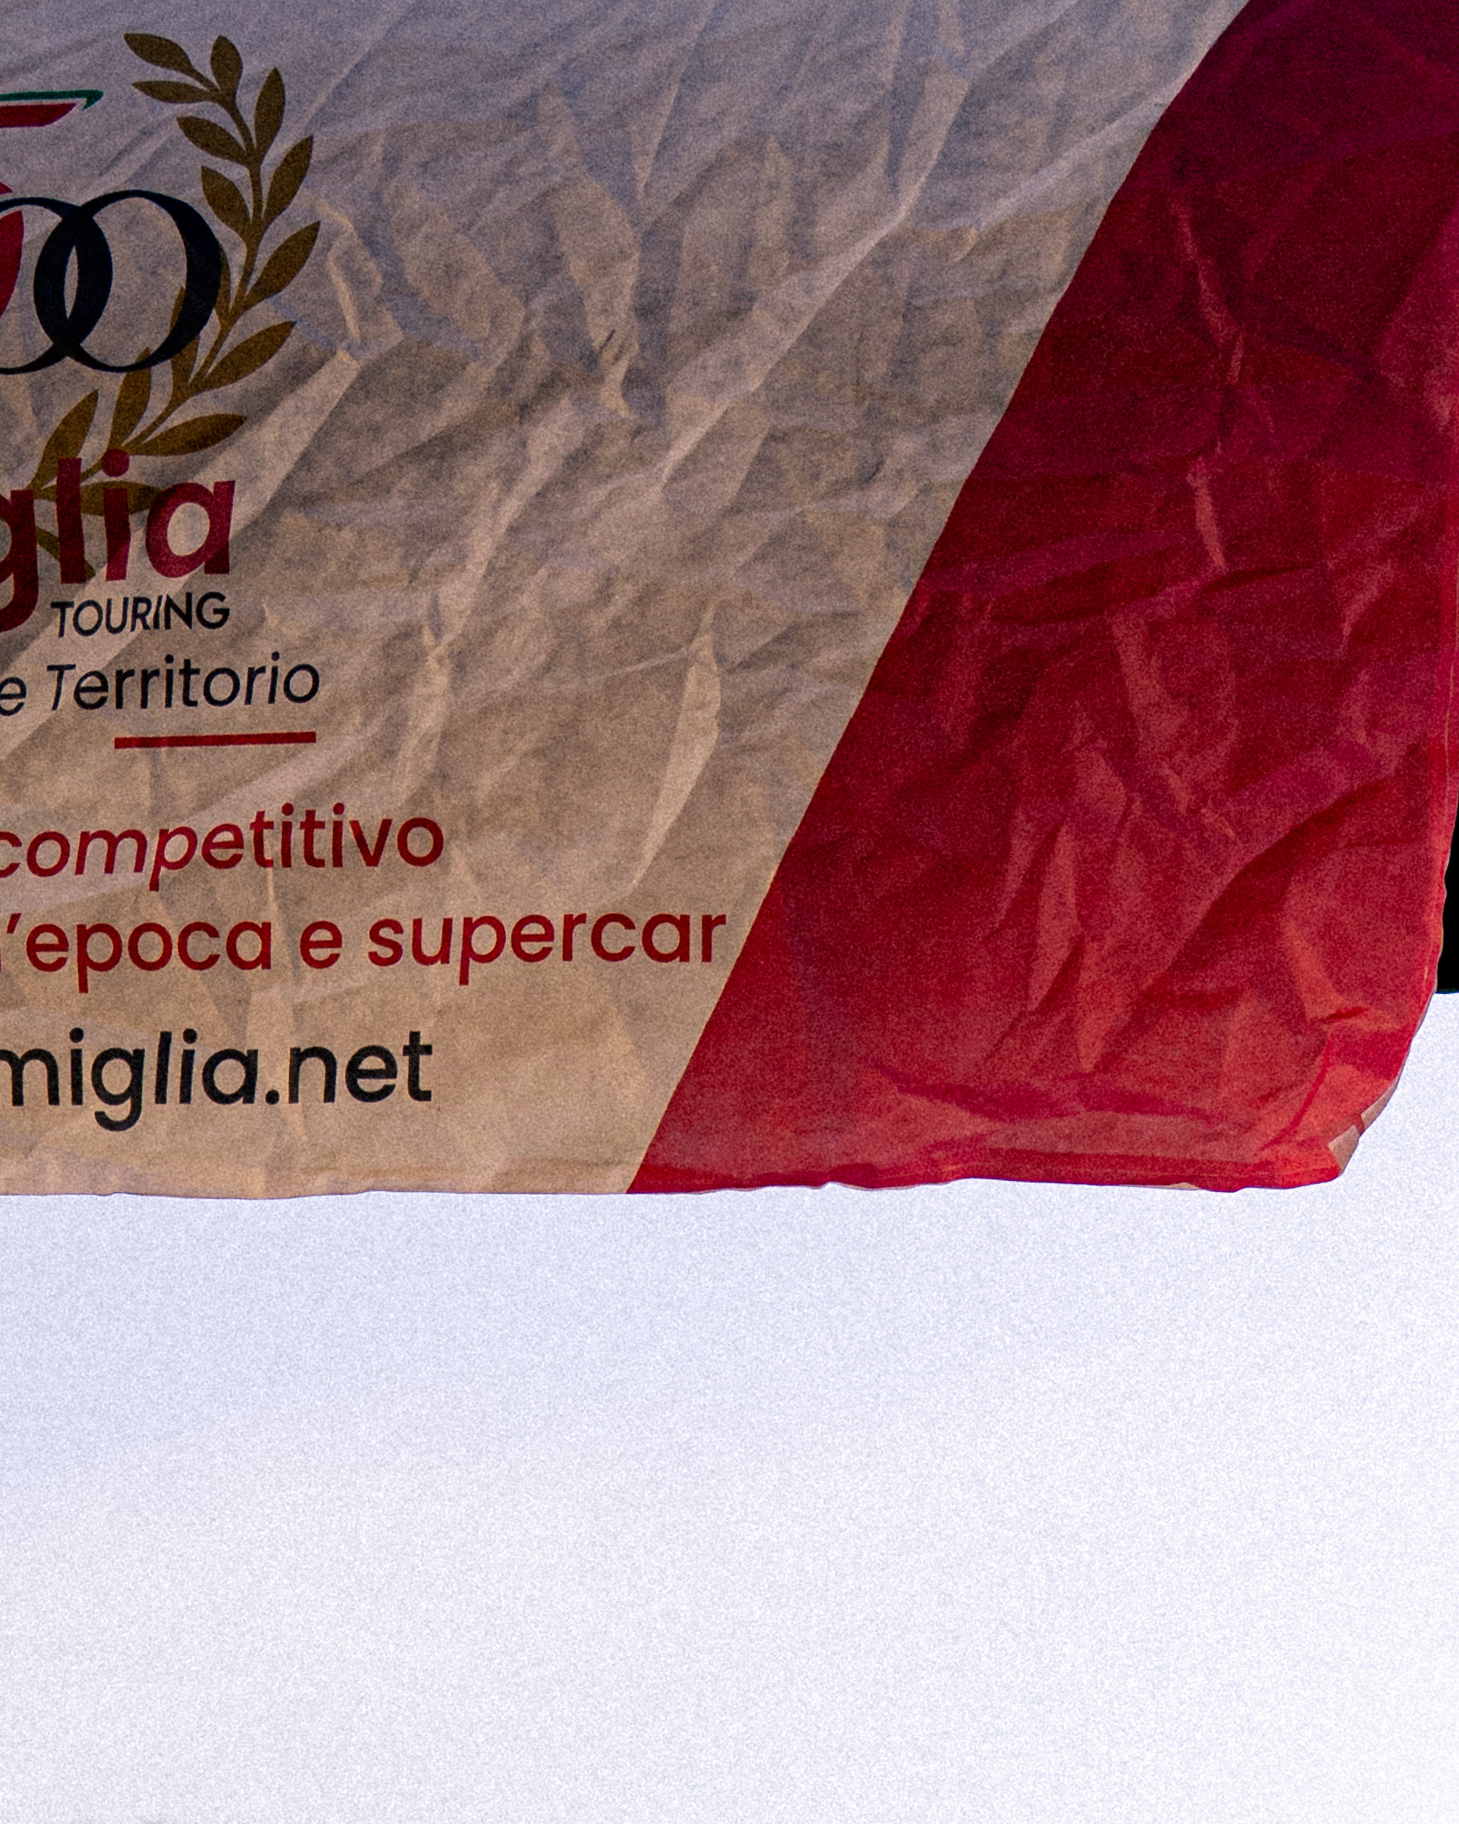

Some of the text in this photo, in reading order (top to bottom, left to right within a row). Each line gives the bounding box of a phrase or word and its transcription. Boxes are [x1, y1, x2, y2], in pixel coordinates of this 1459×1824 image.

[50, 591, 230, 638] TOURING
[46, 651, 322, 713] Territorio
[299, 919, 343, 969] e
[368, 909, 728, 986] supercar
